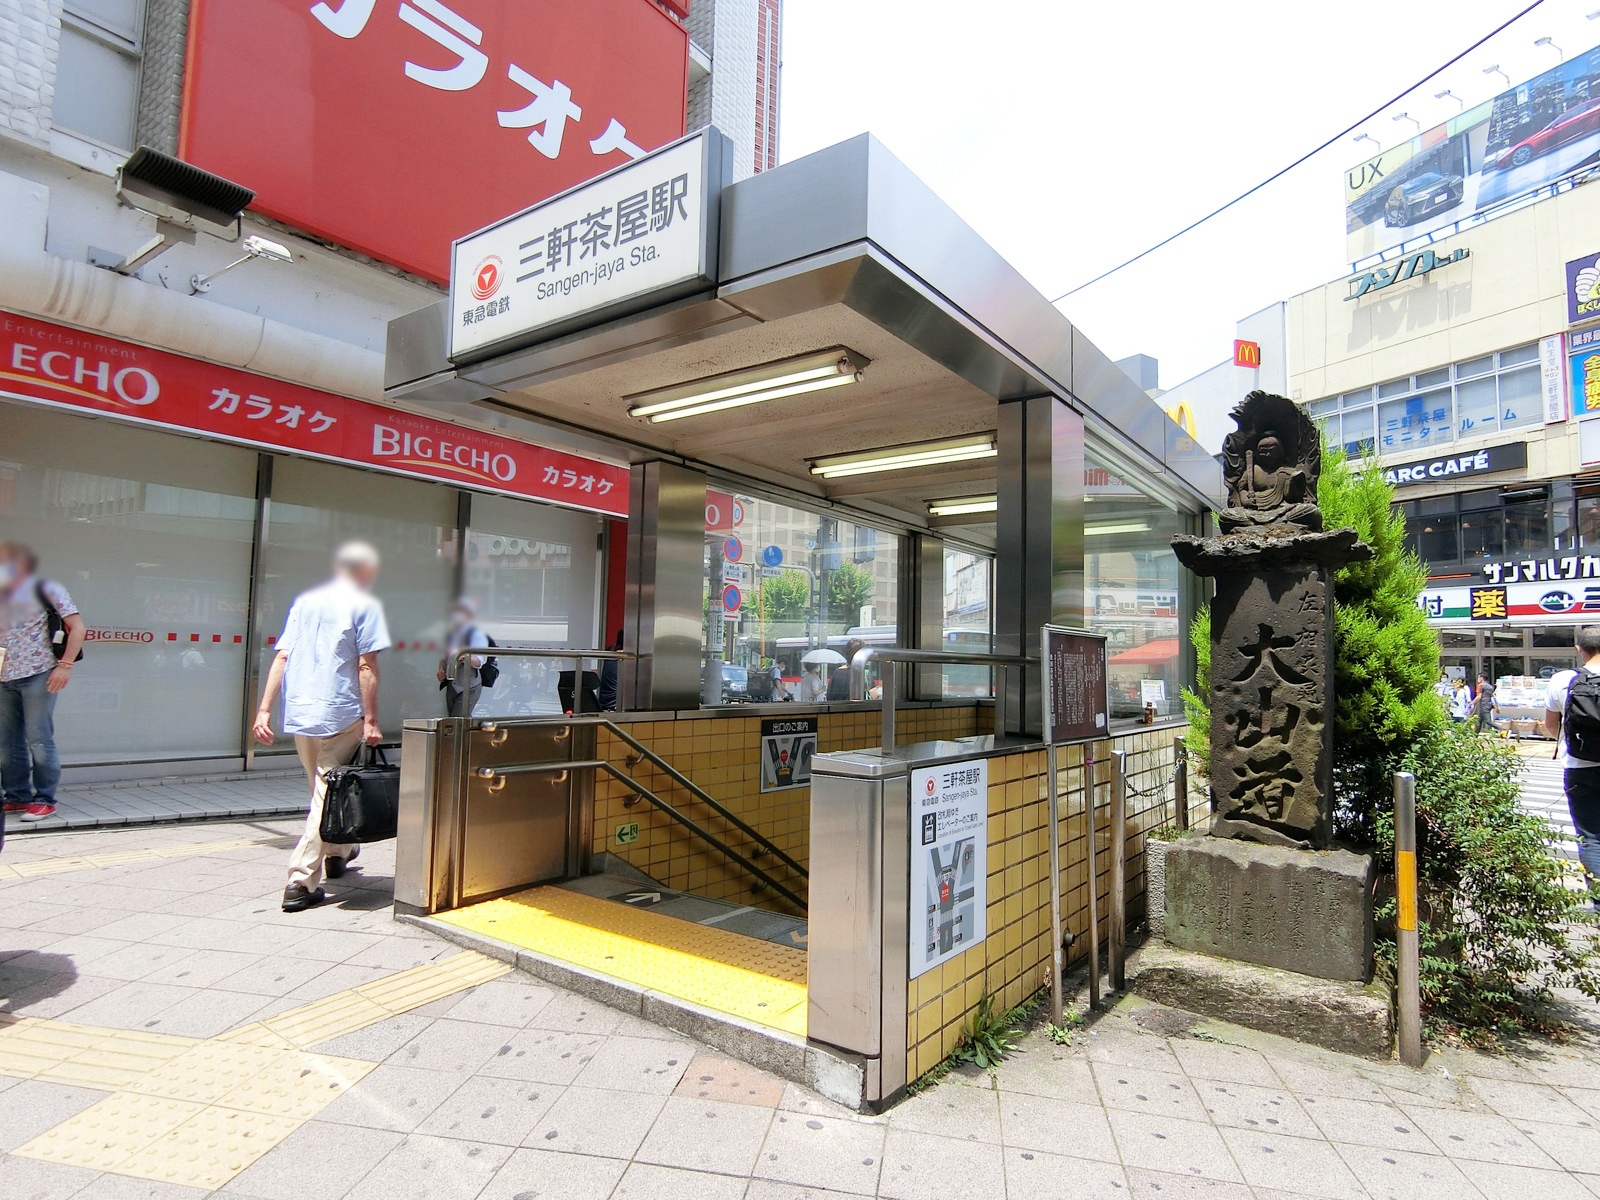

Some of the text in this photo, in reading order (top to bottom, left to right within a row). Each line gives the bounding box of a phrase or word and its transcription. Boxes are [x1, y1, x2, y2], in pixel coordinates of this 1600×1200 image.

[1348, 157, 1385, 191] UX
[516, 172, 689, 283] 三軒茶屋駅
[536, 243, 661, 302] Sangen-jaya Sta.
[462, 295, 511, 327] 東急電鉄
[4, 318, 137, 361] Entertainment
[12, 341, 161, 406] ECHO
[208, 387, 338, 433] カラオケ
[1386, 408, 1446, 432] 三軒茶屋
[388, 414, 505, 449] Karaoke Entertainment
[1382, 408, 1517, 446] モニタールーム
[372, 423, 518, 482] BIG ECHO
[1429, 450, 1490, 477] CAFÉ
[542, 465, 614, 495] カラオケ
[1483, 555, 1600, 584] サンマルクカ
[1472, 589, 1506, 618] 薬
[84, 629, 154, 643] BIG ECHO
[772, 721, 809, 733] 出口のご案内
[1224, 622, 1315, 844] 大山道
[942, 767, 981, 789] 三軒茶屋駅
[921, 796, 939, 807] 東急電鉄
[941, 790, 969, 804] Sangen-jaya
[937, 813, 978, 831] エレベーターのご案内
